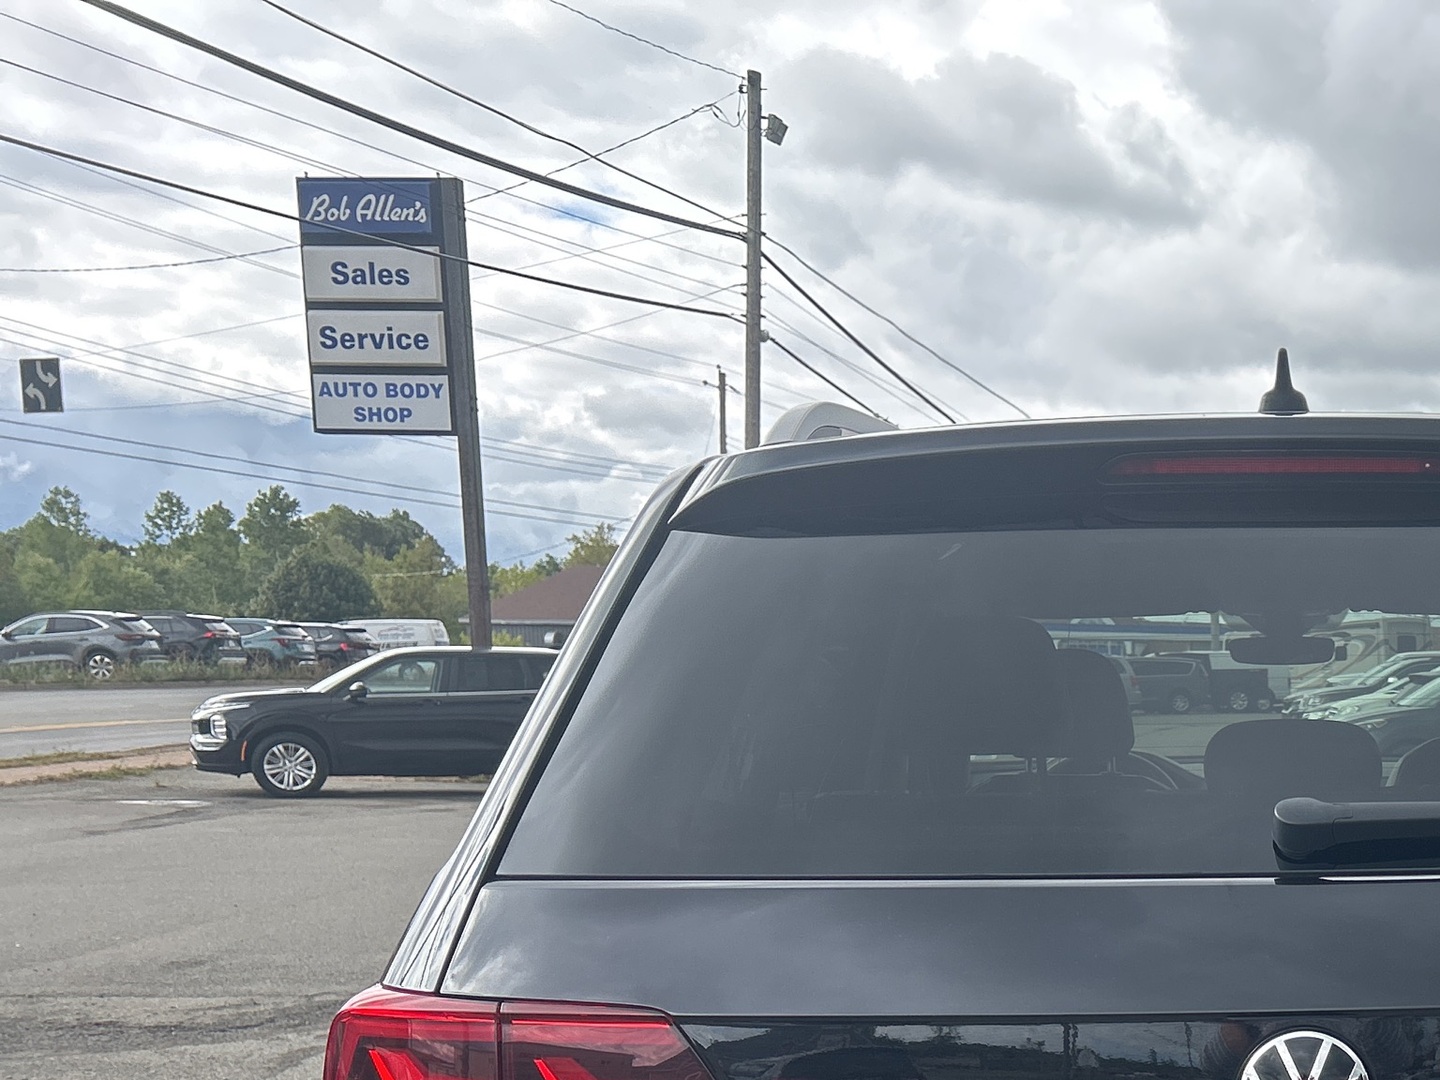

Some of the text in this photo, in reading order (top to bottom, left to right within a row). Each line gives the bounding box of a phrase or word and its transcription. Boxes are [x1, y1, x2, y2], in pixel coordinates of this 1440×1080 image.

[305, 193, 427, 223] Bob Allen's
[330, 261, 410, 286] Sales
[319, 326, 429, 350] Service
[318, 381, 444, 399] AUTO BODY
[353, 406, 412, 423] SHOP
